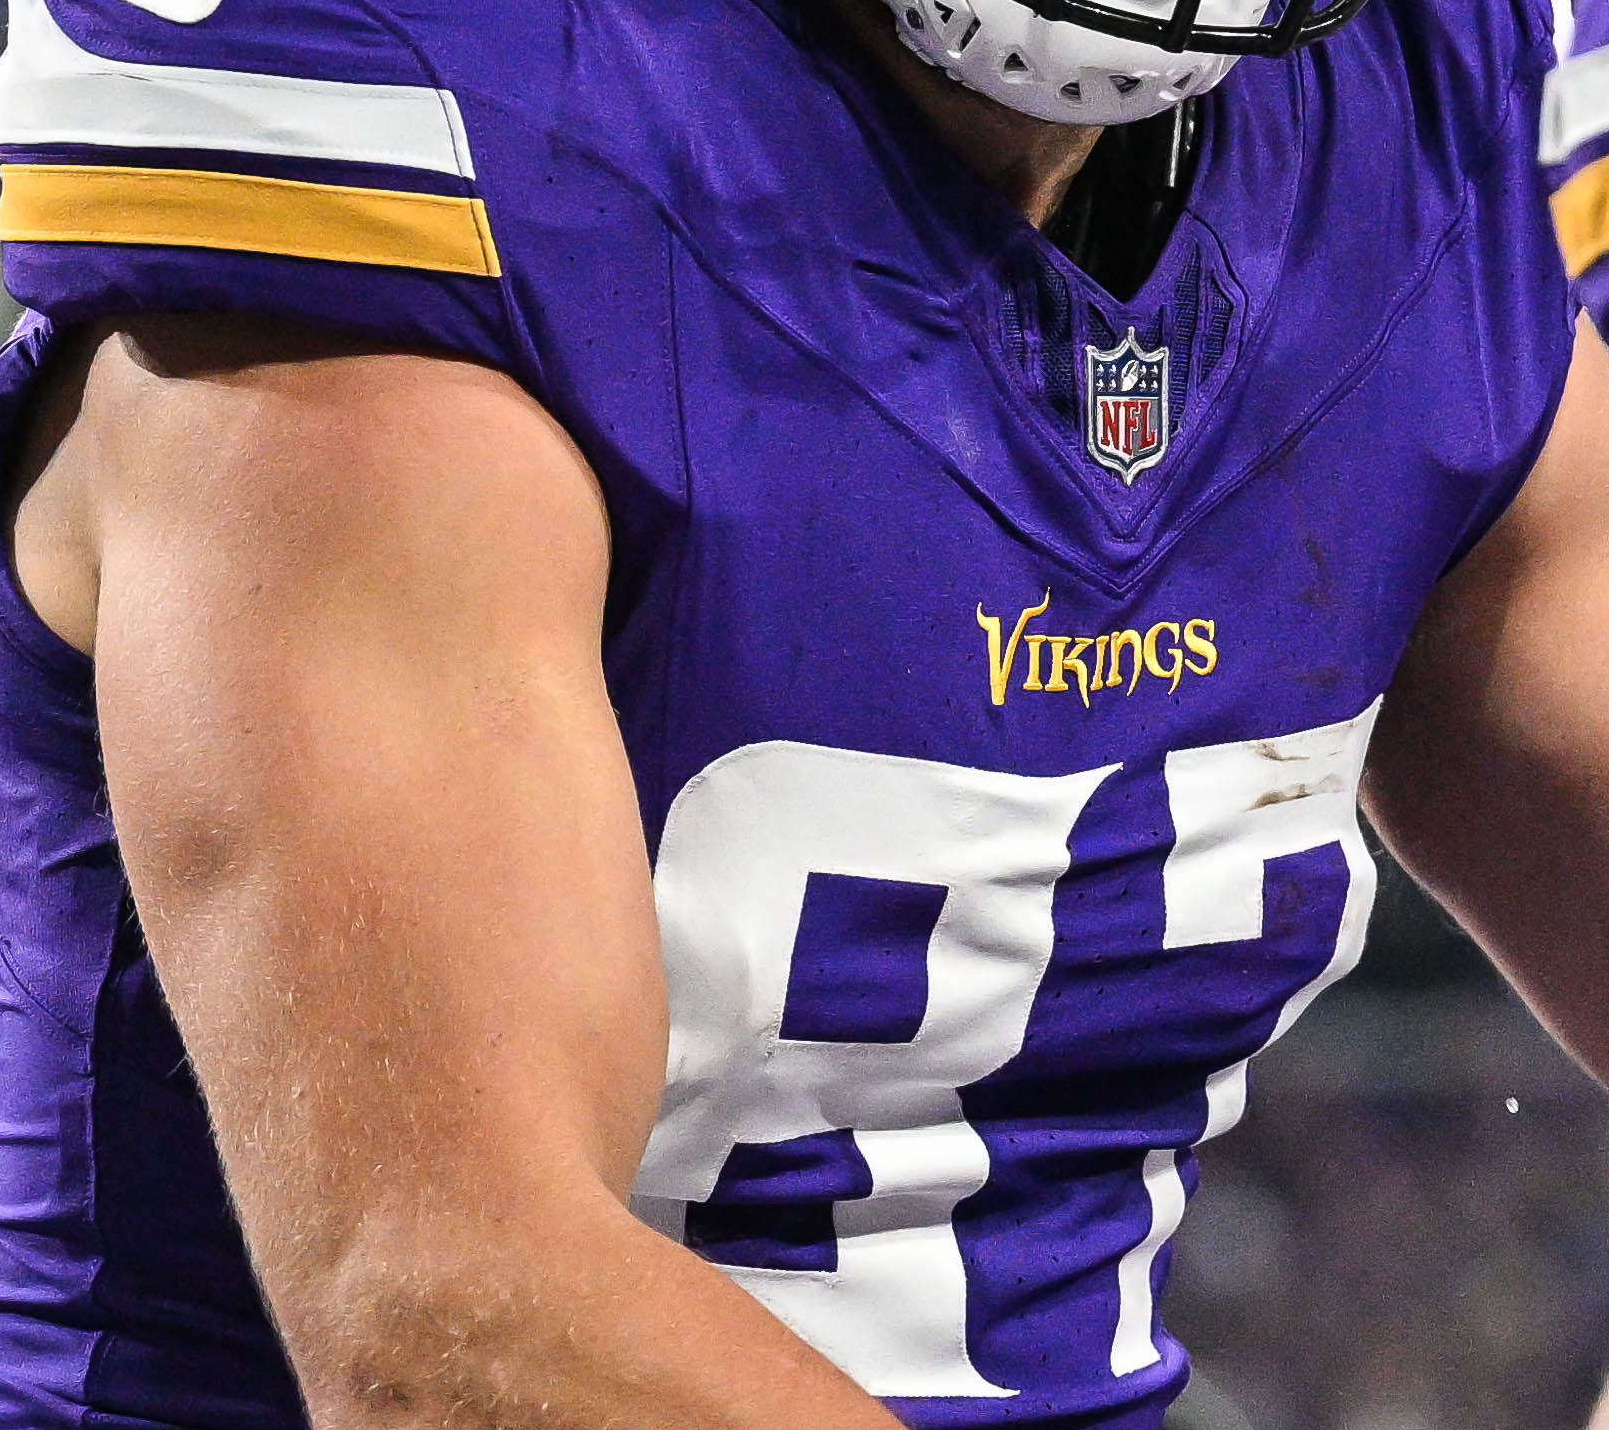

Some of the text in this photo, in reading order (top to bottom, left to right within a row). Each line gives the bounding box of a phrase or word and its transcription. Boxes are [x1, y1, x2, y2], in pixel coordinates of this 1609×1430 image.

[1099, 400, 1157, 455] NFL
[976, 586, 1219, 708] VIKINGS
[626, 695, 1385, 1399] 87
